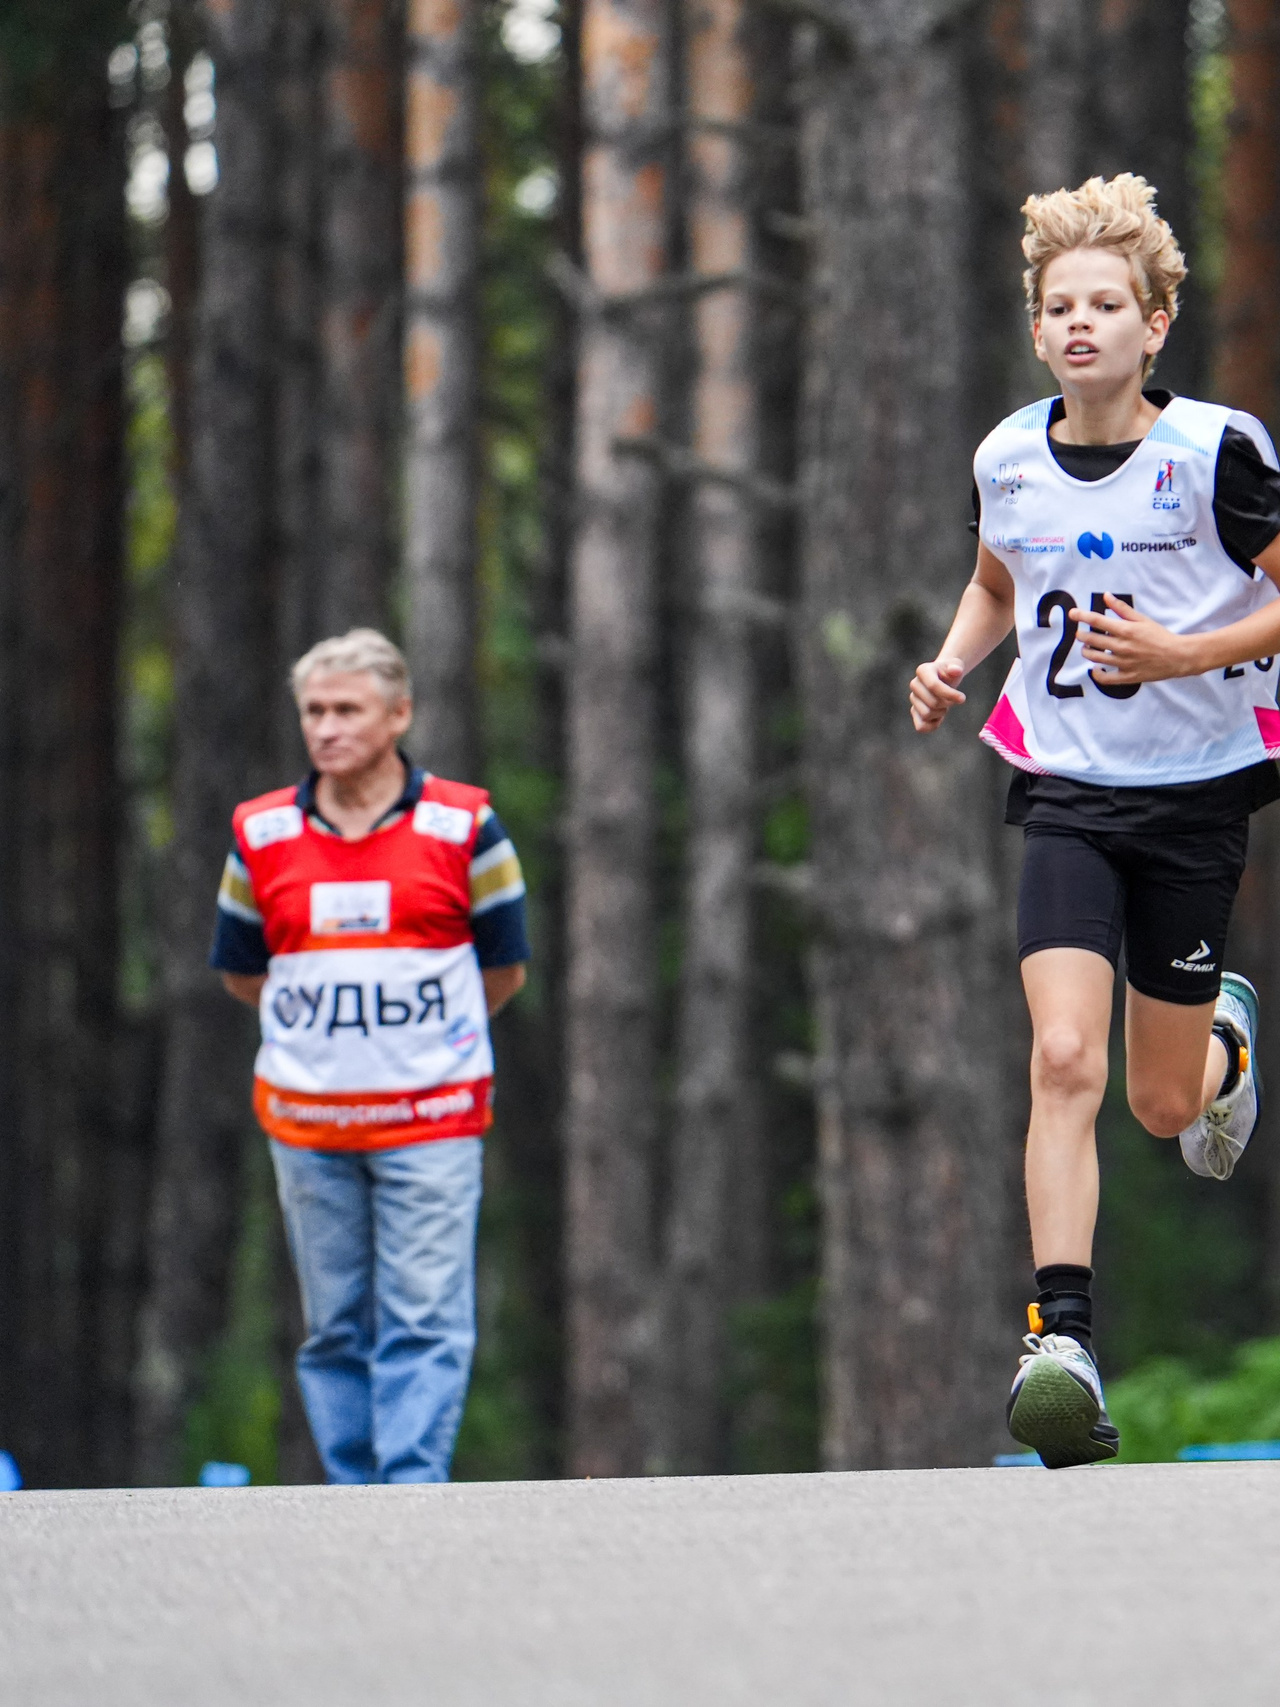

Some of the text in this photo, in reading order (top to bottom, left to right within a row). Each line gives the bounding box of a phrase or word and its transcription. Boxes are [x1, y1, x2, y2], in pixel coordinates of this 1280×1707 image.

[1004, 497, 1019, 505] FISU
[1152, 502, 1181, 510] СБР
[1050, 545, 1065, 553] 2019
[1121, 537, 1197, 552] НОРНИКЕЛЬ
[1170, 959, 1217, 972] DEMIX
[272, 977, 446, 1037] СУДЬЯ
